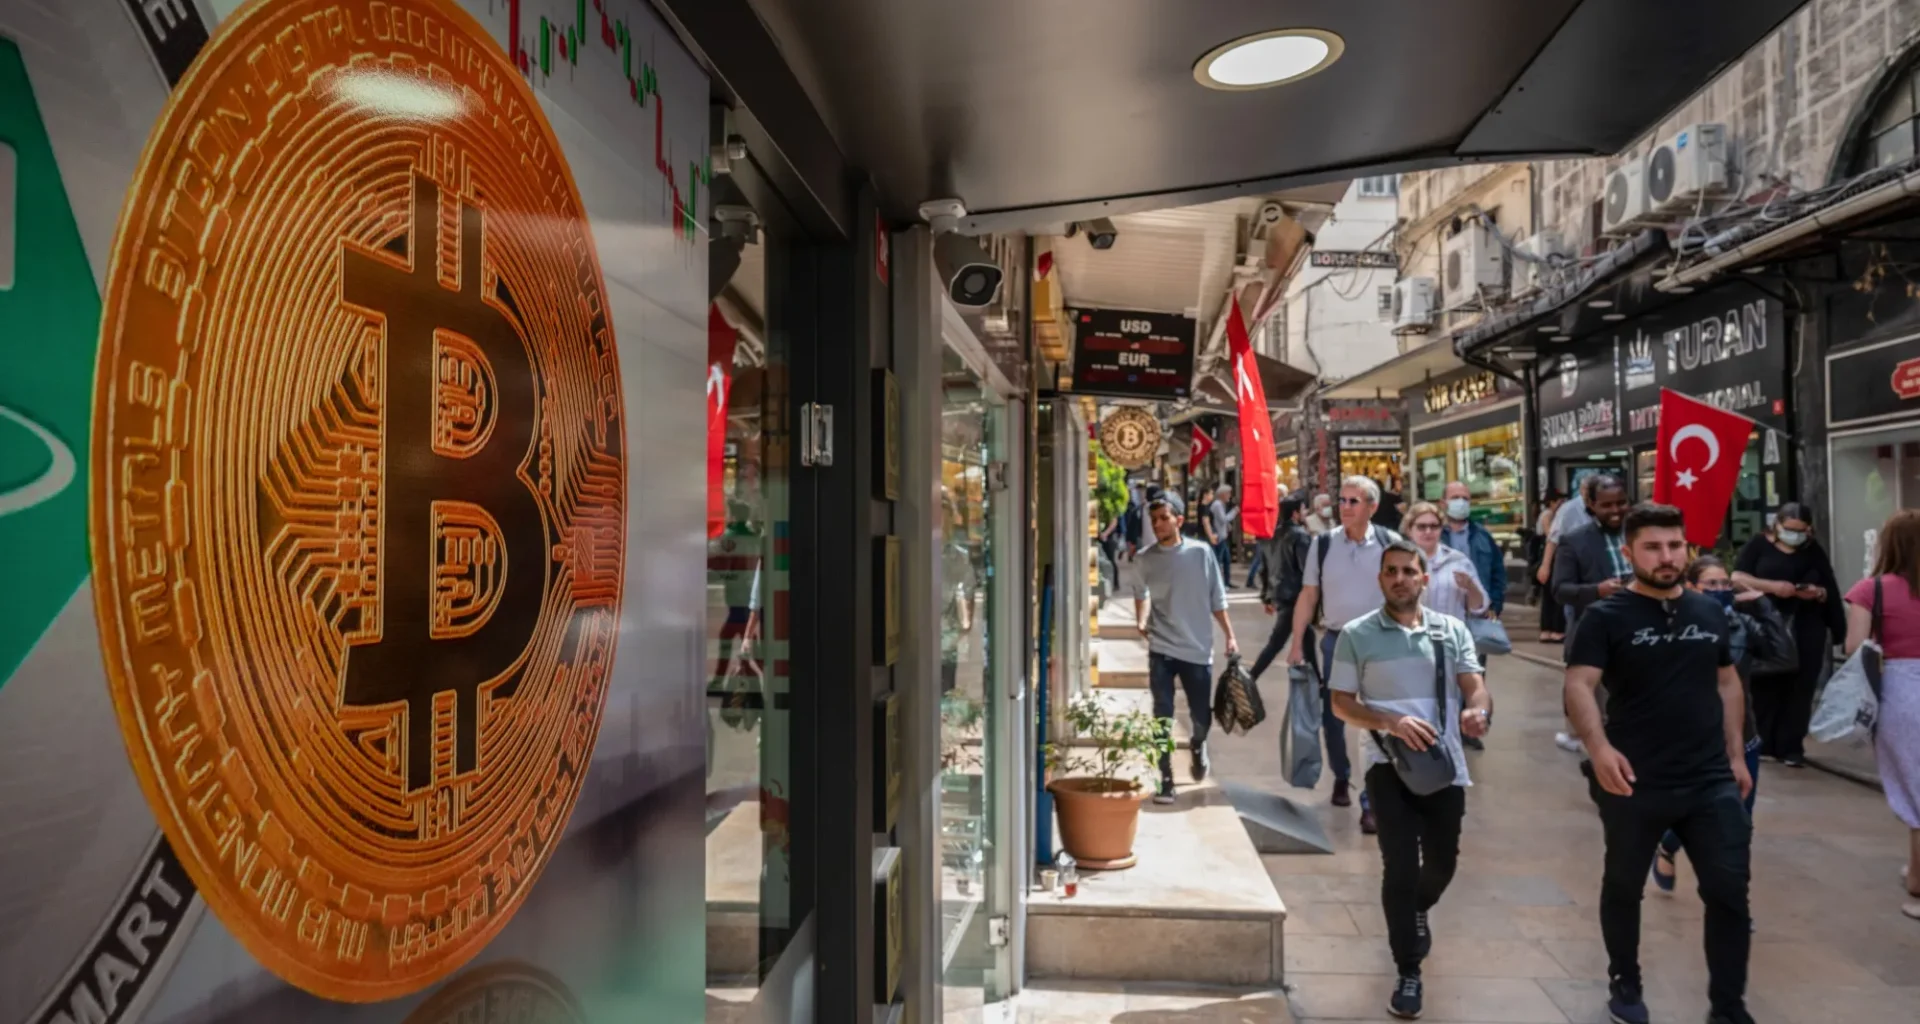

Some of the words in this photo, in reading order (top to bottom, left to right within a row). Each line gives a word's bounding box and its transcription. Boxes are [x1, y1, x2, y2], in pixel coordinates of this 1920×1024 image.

[144, 88, 252, 301] BITCOIN
[247, 4, 366, 96] DIGITAL
[368, 1, 548, 170] DECENTRALIZED
[595, 327, 617, 423] PEER
[1118, 352, 1150, 366] EUR
[1119, 319, 1152, 333] USD
[1663, 299, 1767, 375] TURAN
[1541, 410, 1578, 448] SUNA
[122, 359, 172, 644] METALS
[151, 662, 299, 926] MONETARY
[493, 830, 536, 906] FINE
[388, 883, 489, 971] COPPER
